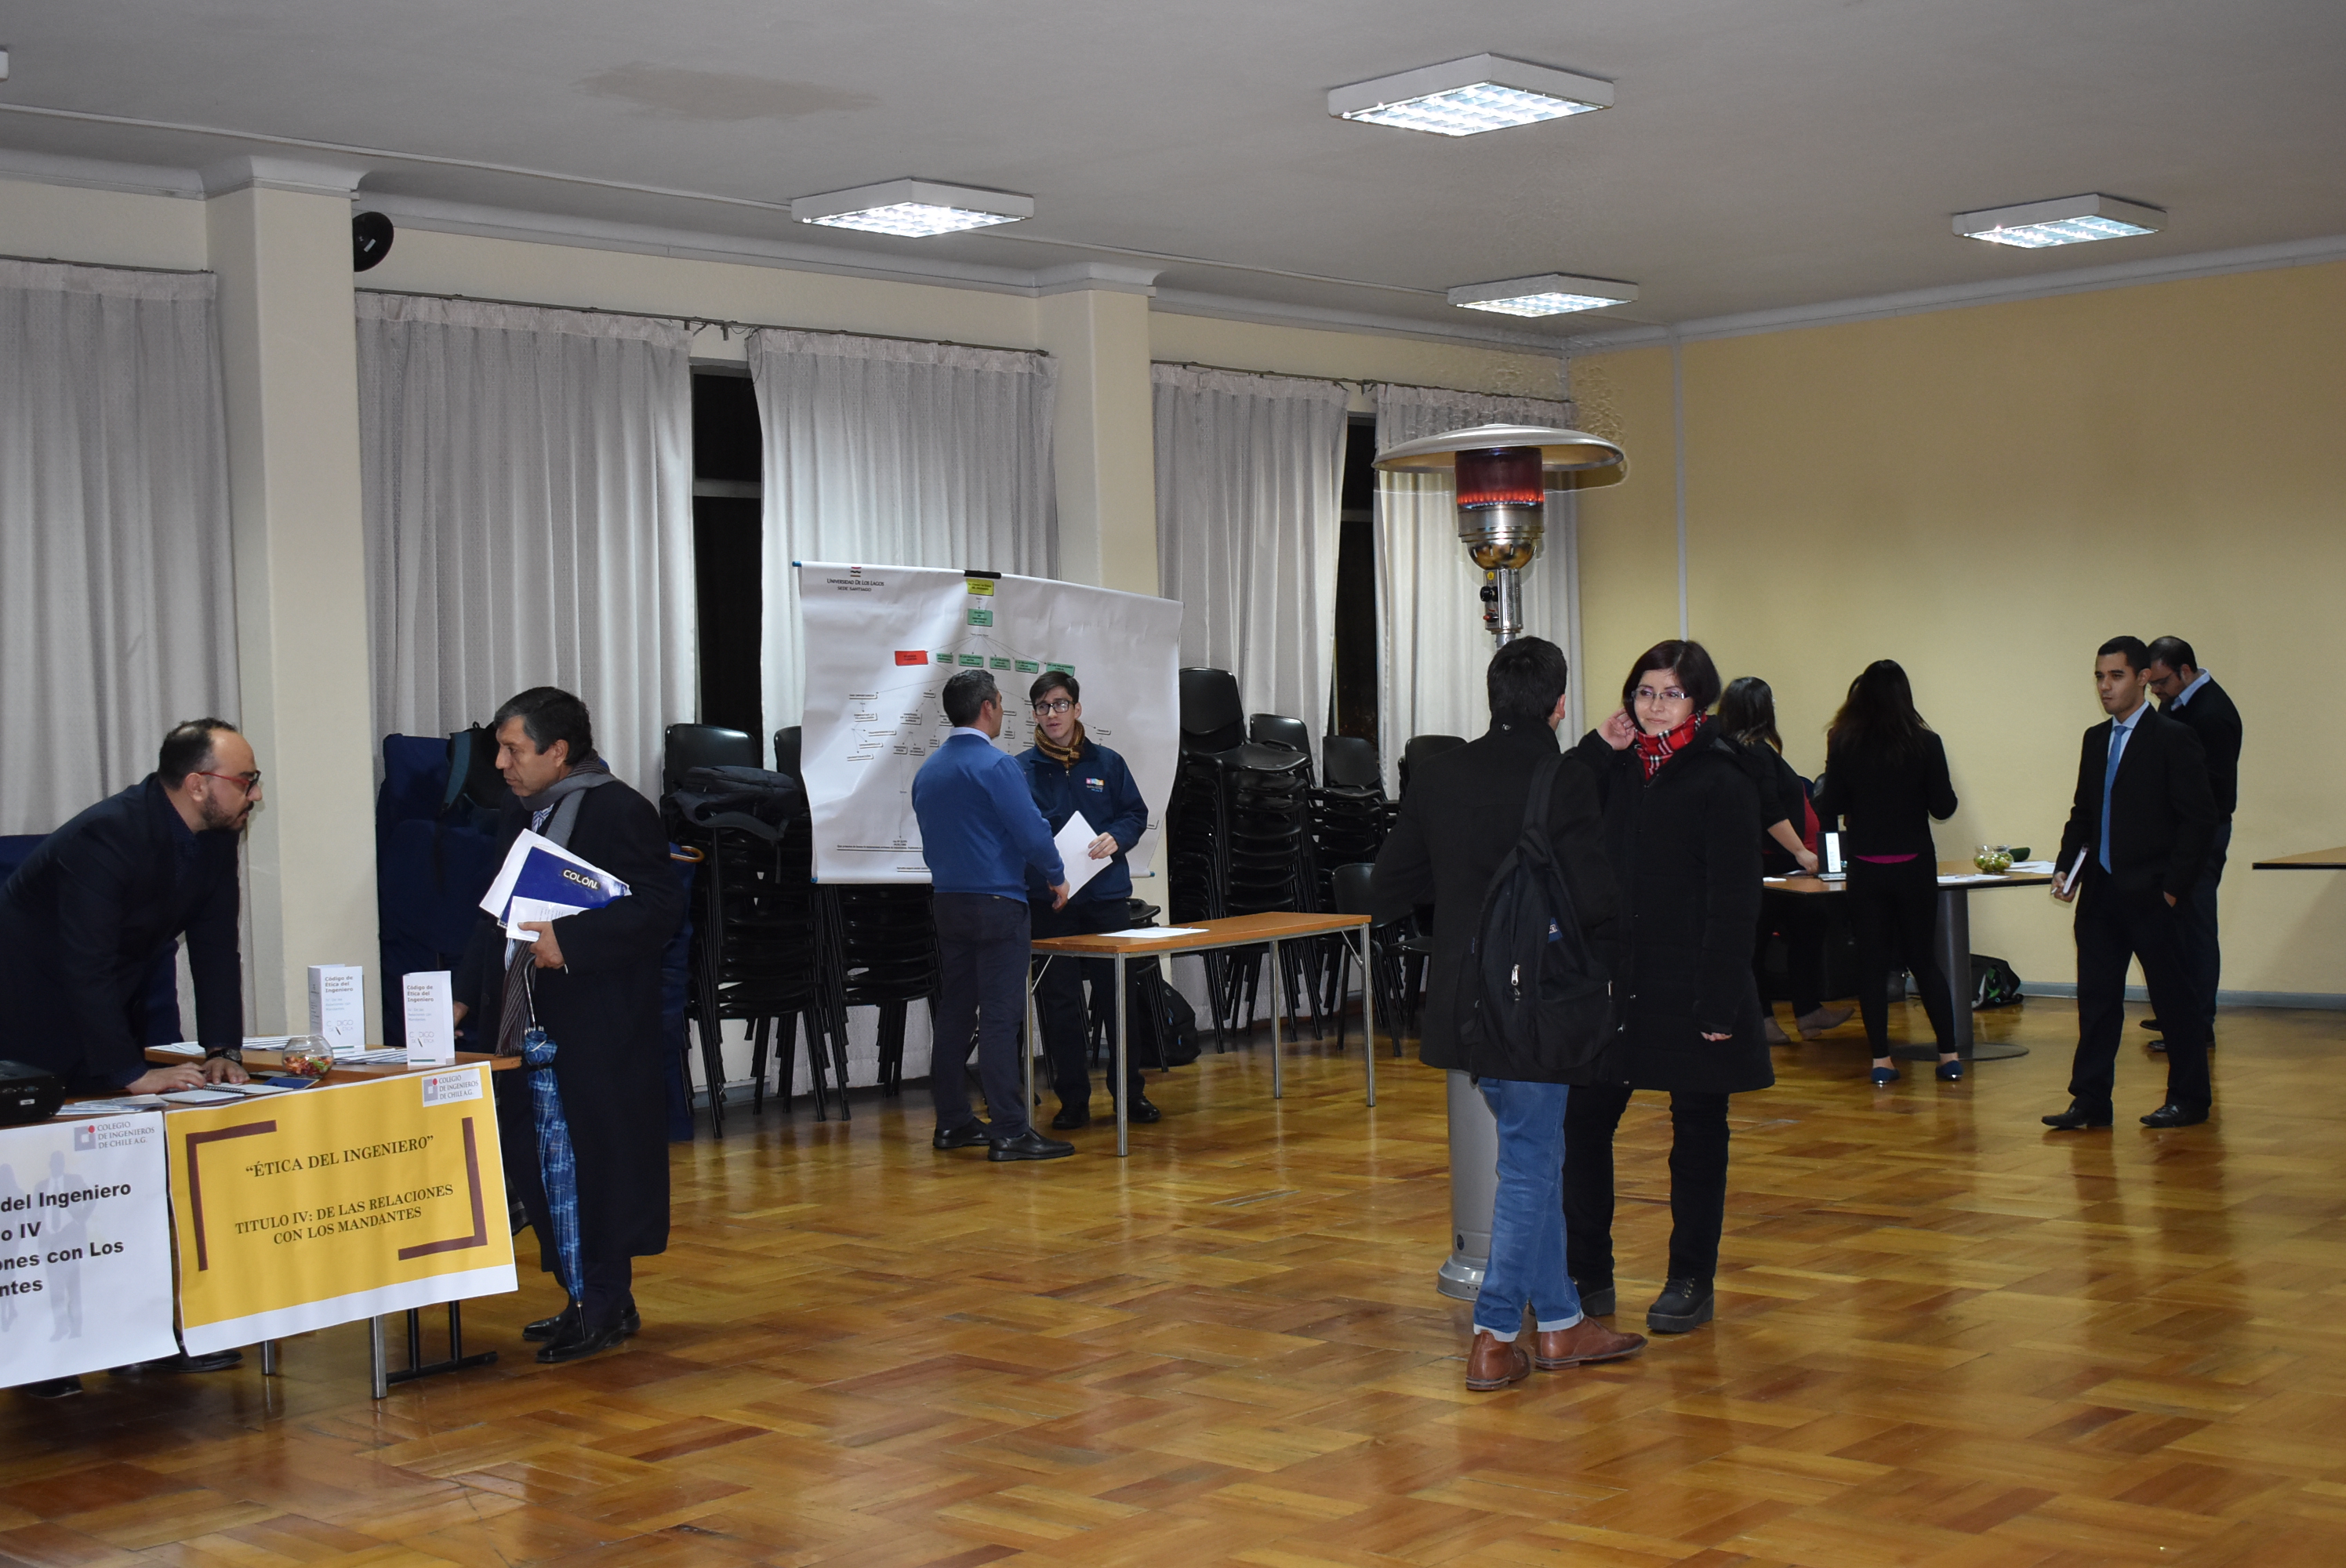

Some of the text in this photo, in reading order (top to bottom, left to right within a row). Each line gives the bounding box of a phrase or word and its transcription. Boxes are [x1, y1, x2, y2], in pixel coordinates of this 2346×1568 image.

[438, 1075, 462, 1084] COLEGIO
[447, 1080, 479, 1090] INGENIEROS
[447, 1091, 463, 1099] CHILE
[97, 1121, 131, 1131] COLEGIO
[110, 1127, 155, 1139] INGENIEROS
[110, 1138, 132, 1148] CHILE
[307, 1152, 340, 1169] DEL
[1, 1183, 132, 1213] del Ingeniero
[235, 1184, 454, 1235] TITULO IV: DE LAS RELACIONES
[20, 1221, 42, 1239] IV
[274, 1206, 422, 1245] CON LOS MANDANTES
[0, 1241, 125, 1271] nes con Los
